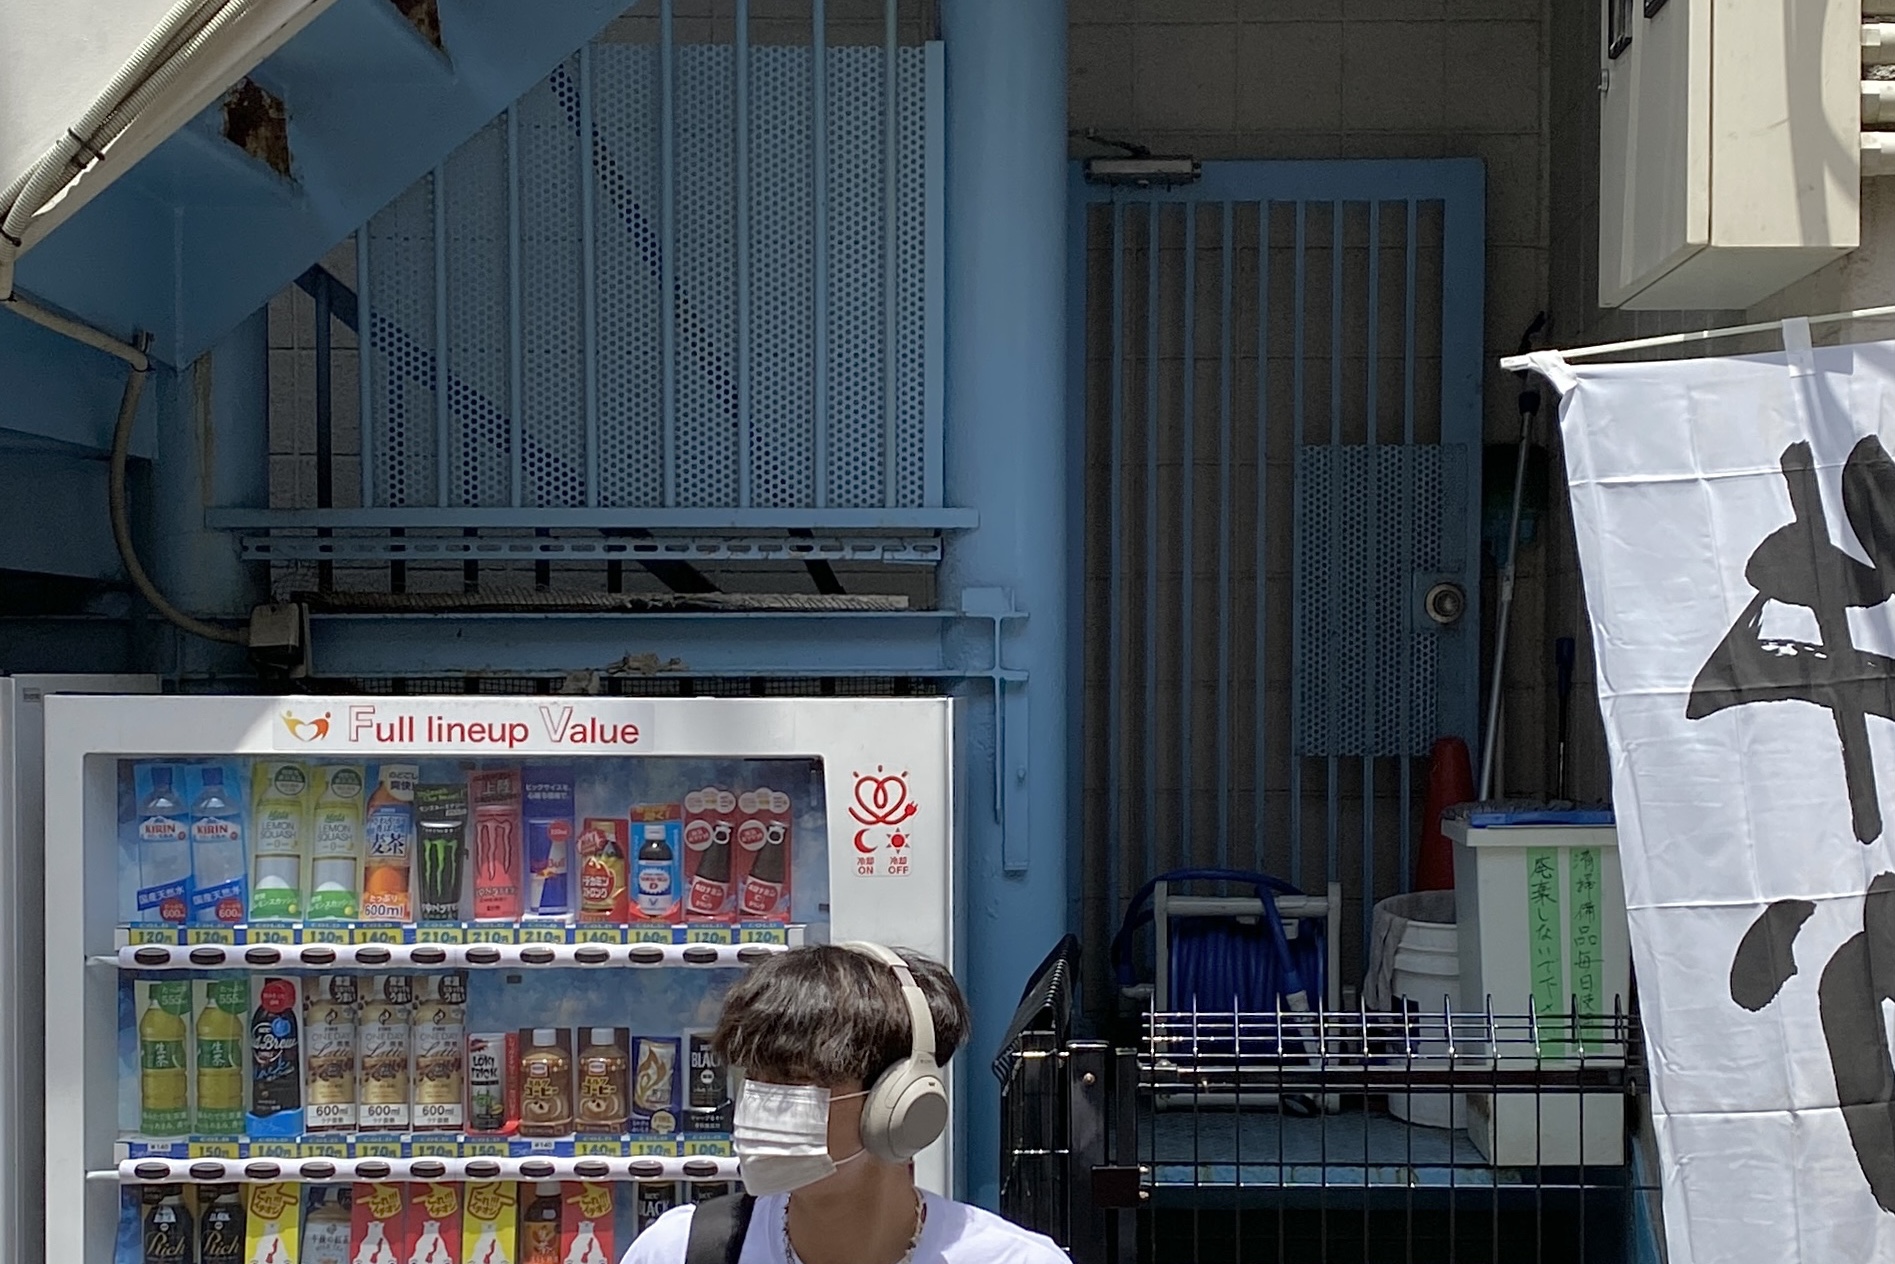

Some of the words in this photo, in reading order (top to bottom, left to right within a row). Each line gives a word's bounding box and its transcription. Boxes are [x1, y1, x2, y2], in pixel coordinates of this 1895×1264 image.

[349, 705, 414, 744] Full
[427, 715, 529, 749] lineup
[538, 705, 640, 745] Value
[145, 823, 176, 834] KIRIN
[196, 823, 229, 834] KIRIN
[261, 821, 295, 831] LEMON
[318, 824, 351, 833] LEMON
[371, 833, 405, 855] 麦茶
[858, 866, 873, 875] ON
[887, 866, 909, 875] OFF
[364, 904, 403, 917] 600ml
[316, 1104, 349, 1116] 600ml
[368, 1104, 401, 1116] 600ml
[422, 1104, 455, 1116] 600ml
[146, 1231, 186, 1256] Rich
[203, 1231, 240, 1256] Rich
